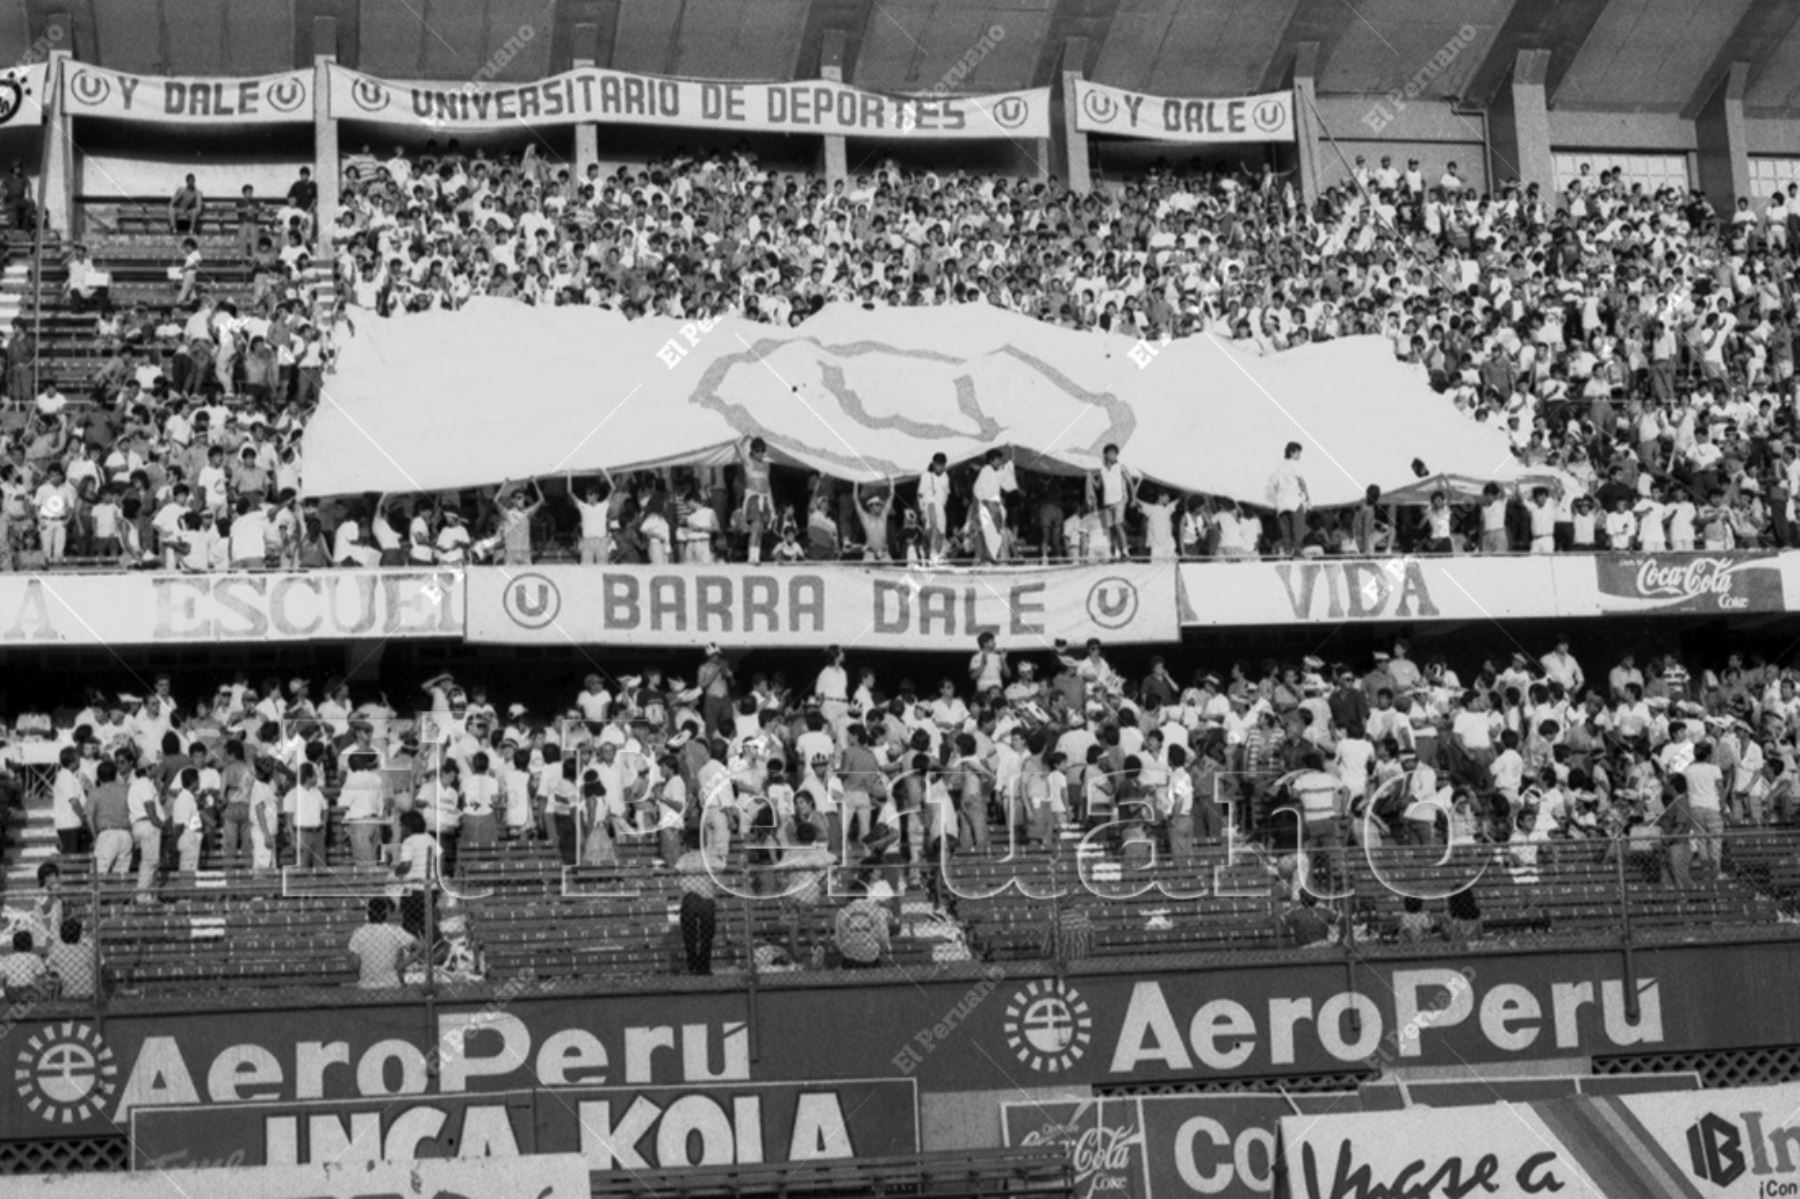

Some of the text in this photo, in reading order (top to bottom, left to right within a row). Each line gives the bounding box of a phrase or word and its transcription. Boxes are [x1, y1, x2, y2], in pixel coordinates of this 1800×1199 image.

[117, 76, 139, 110] Y
[164, 81, 259, 116] DALE
[411, 75, 680, 120] UNIVERSITARIO
[702, 85, 745, 122] DE
[767, 87, 966, 130] DEPORTES
[1124, 95, 1143, 127] Y
[1162, 100, 1246, 133] DALE
[1275, 562, 1440, 619] VIDA
[1637, 557, 1733, 596] Coca-Cola
[603, 573, 825, 632] BARRA
[873, 579, 1046, 635] DALE
